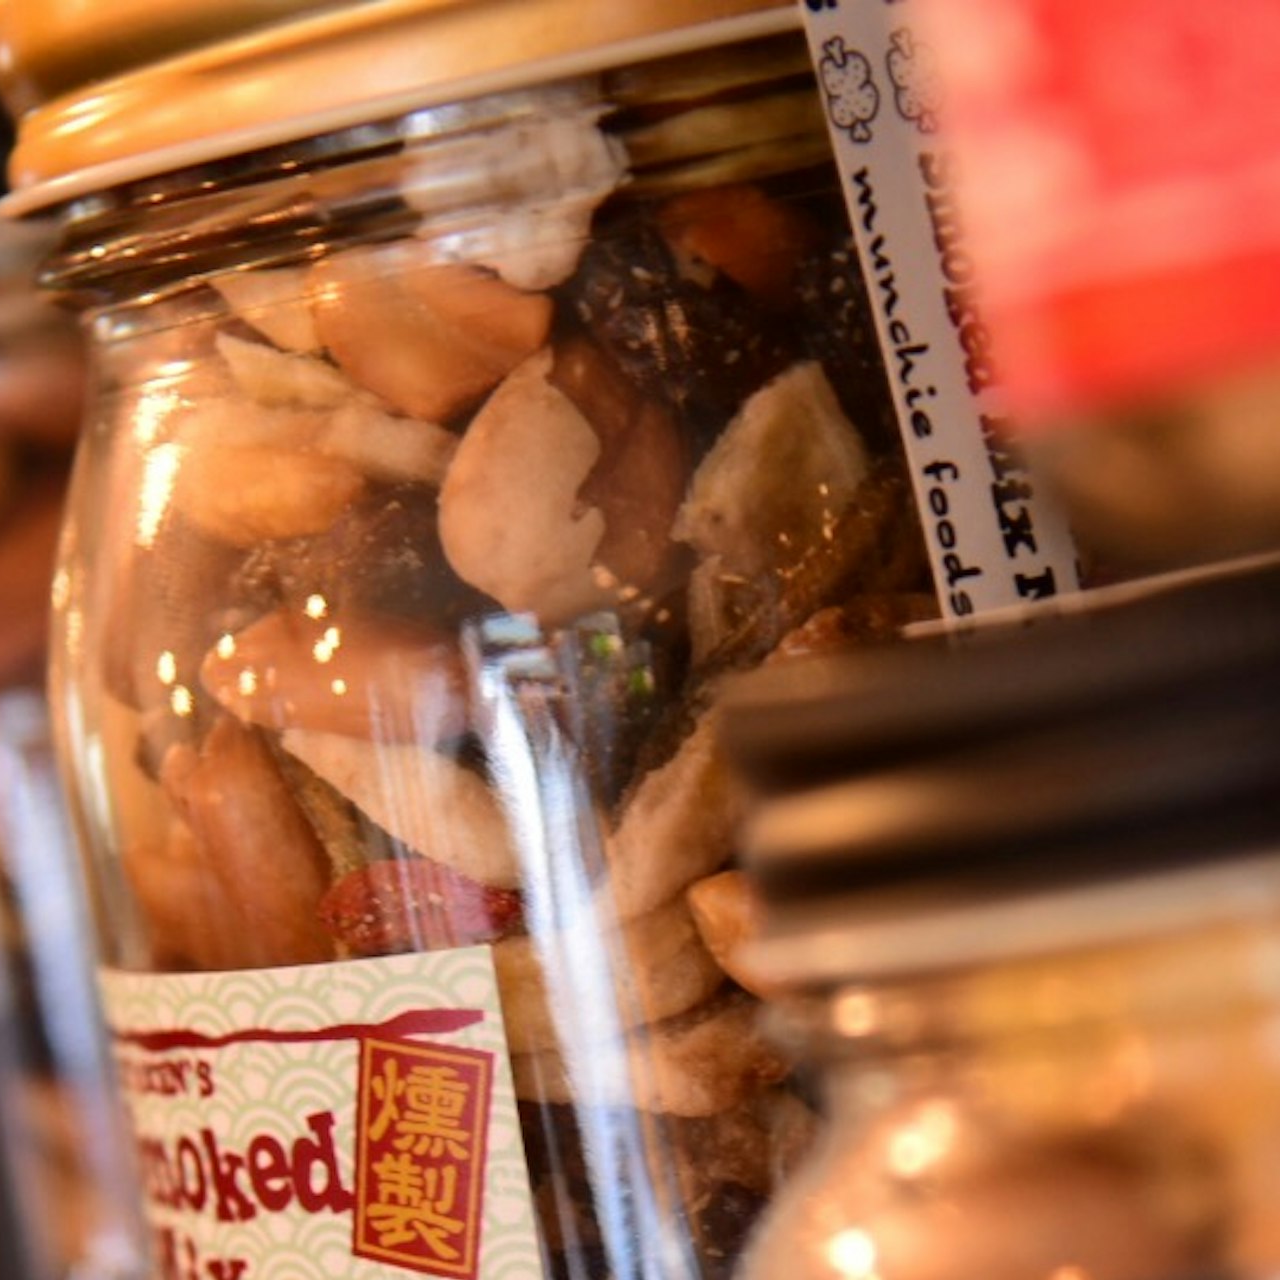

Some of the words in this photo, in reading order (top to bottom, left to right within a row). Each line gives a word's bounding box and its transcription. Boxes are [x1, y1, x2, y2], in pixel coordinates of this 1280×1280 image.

[852, 166, 937, 439] munchie
[923, 460, 983, 617] foods
[978, 413, 1039, 559] Mix
[135, 1110, 356, 1223] moked
[367, 1057, 471, 1261] 燻製
